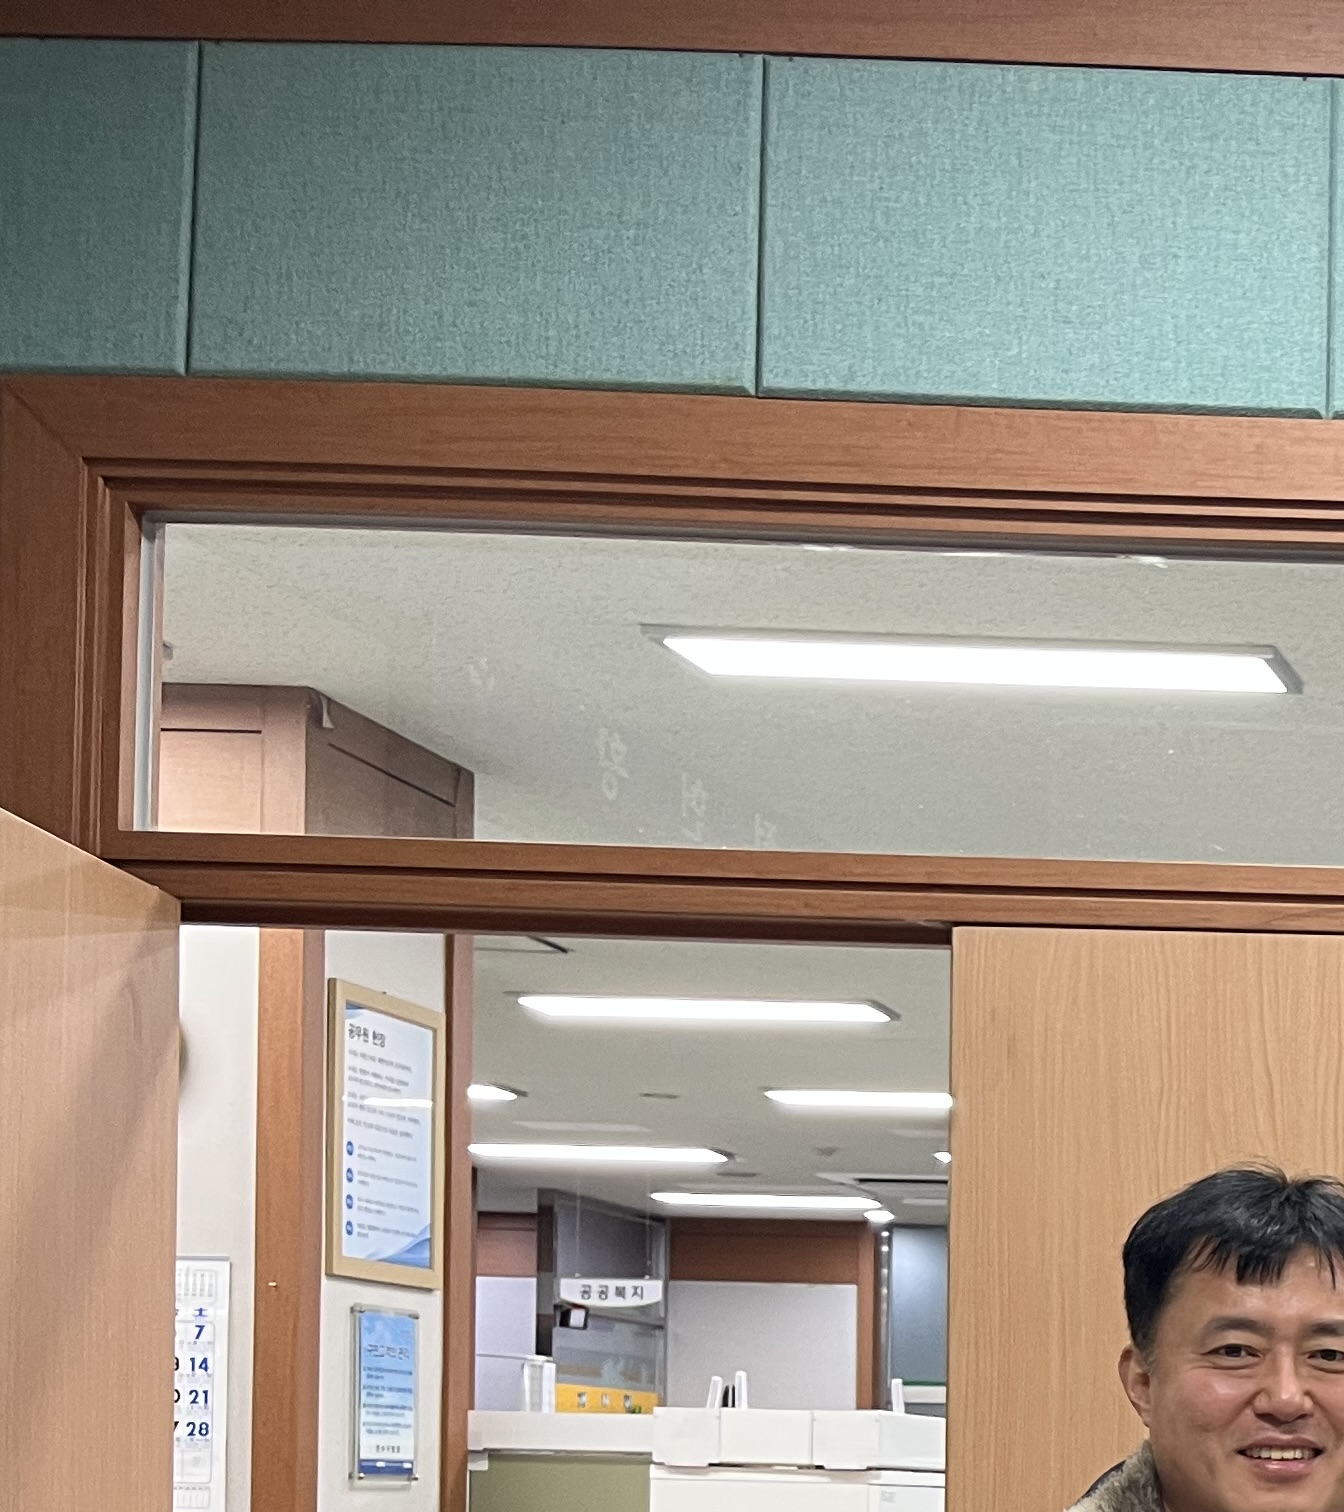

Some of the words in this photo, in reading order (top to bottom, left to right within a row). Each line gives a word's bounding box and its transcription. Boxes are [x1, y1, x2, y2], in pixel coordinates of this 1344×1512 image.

[580, 1284, 644, 1301] 공공복지
[194, 1324, 205, 1340] 7
[189, 1357, 209, 1372] 14
[188, 1389, 209, 1405] 21
[186, 1421, 210, 1437] 28
